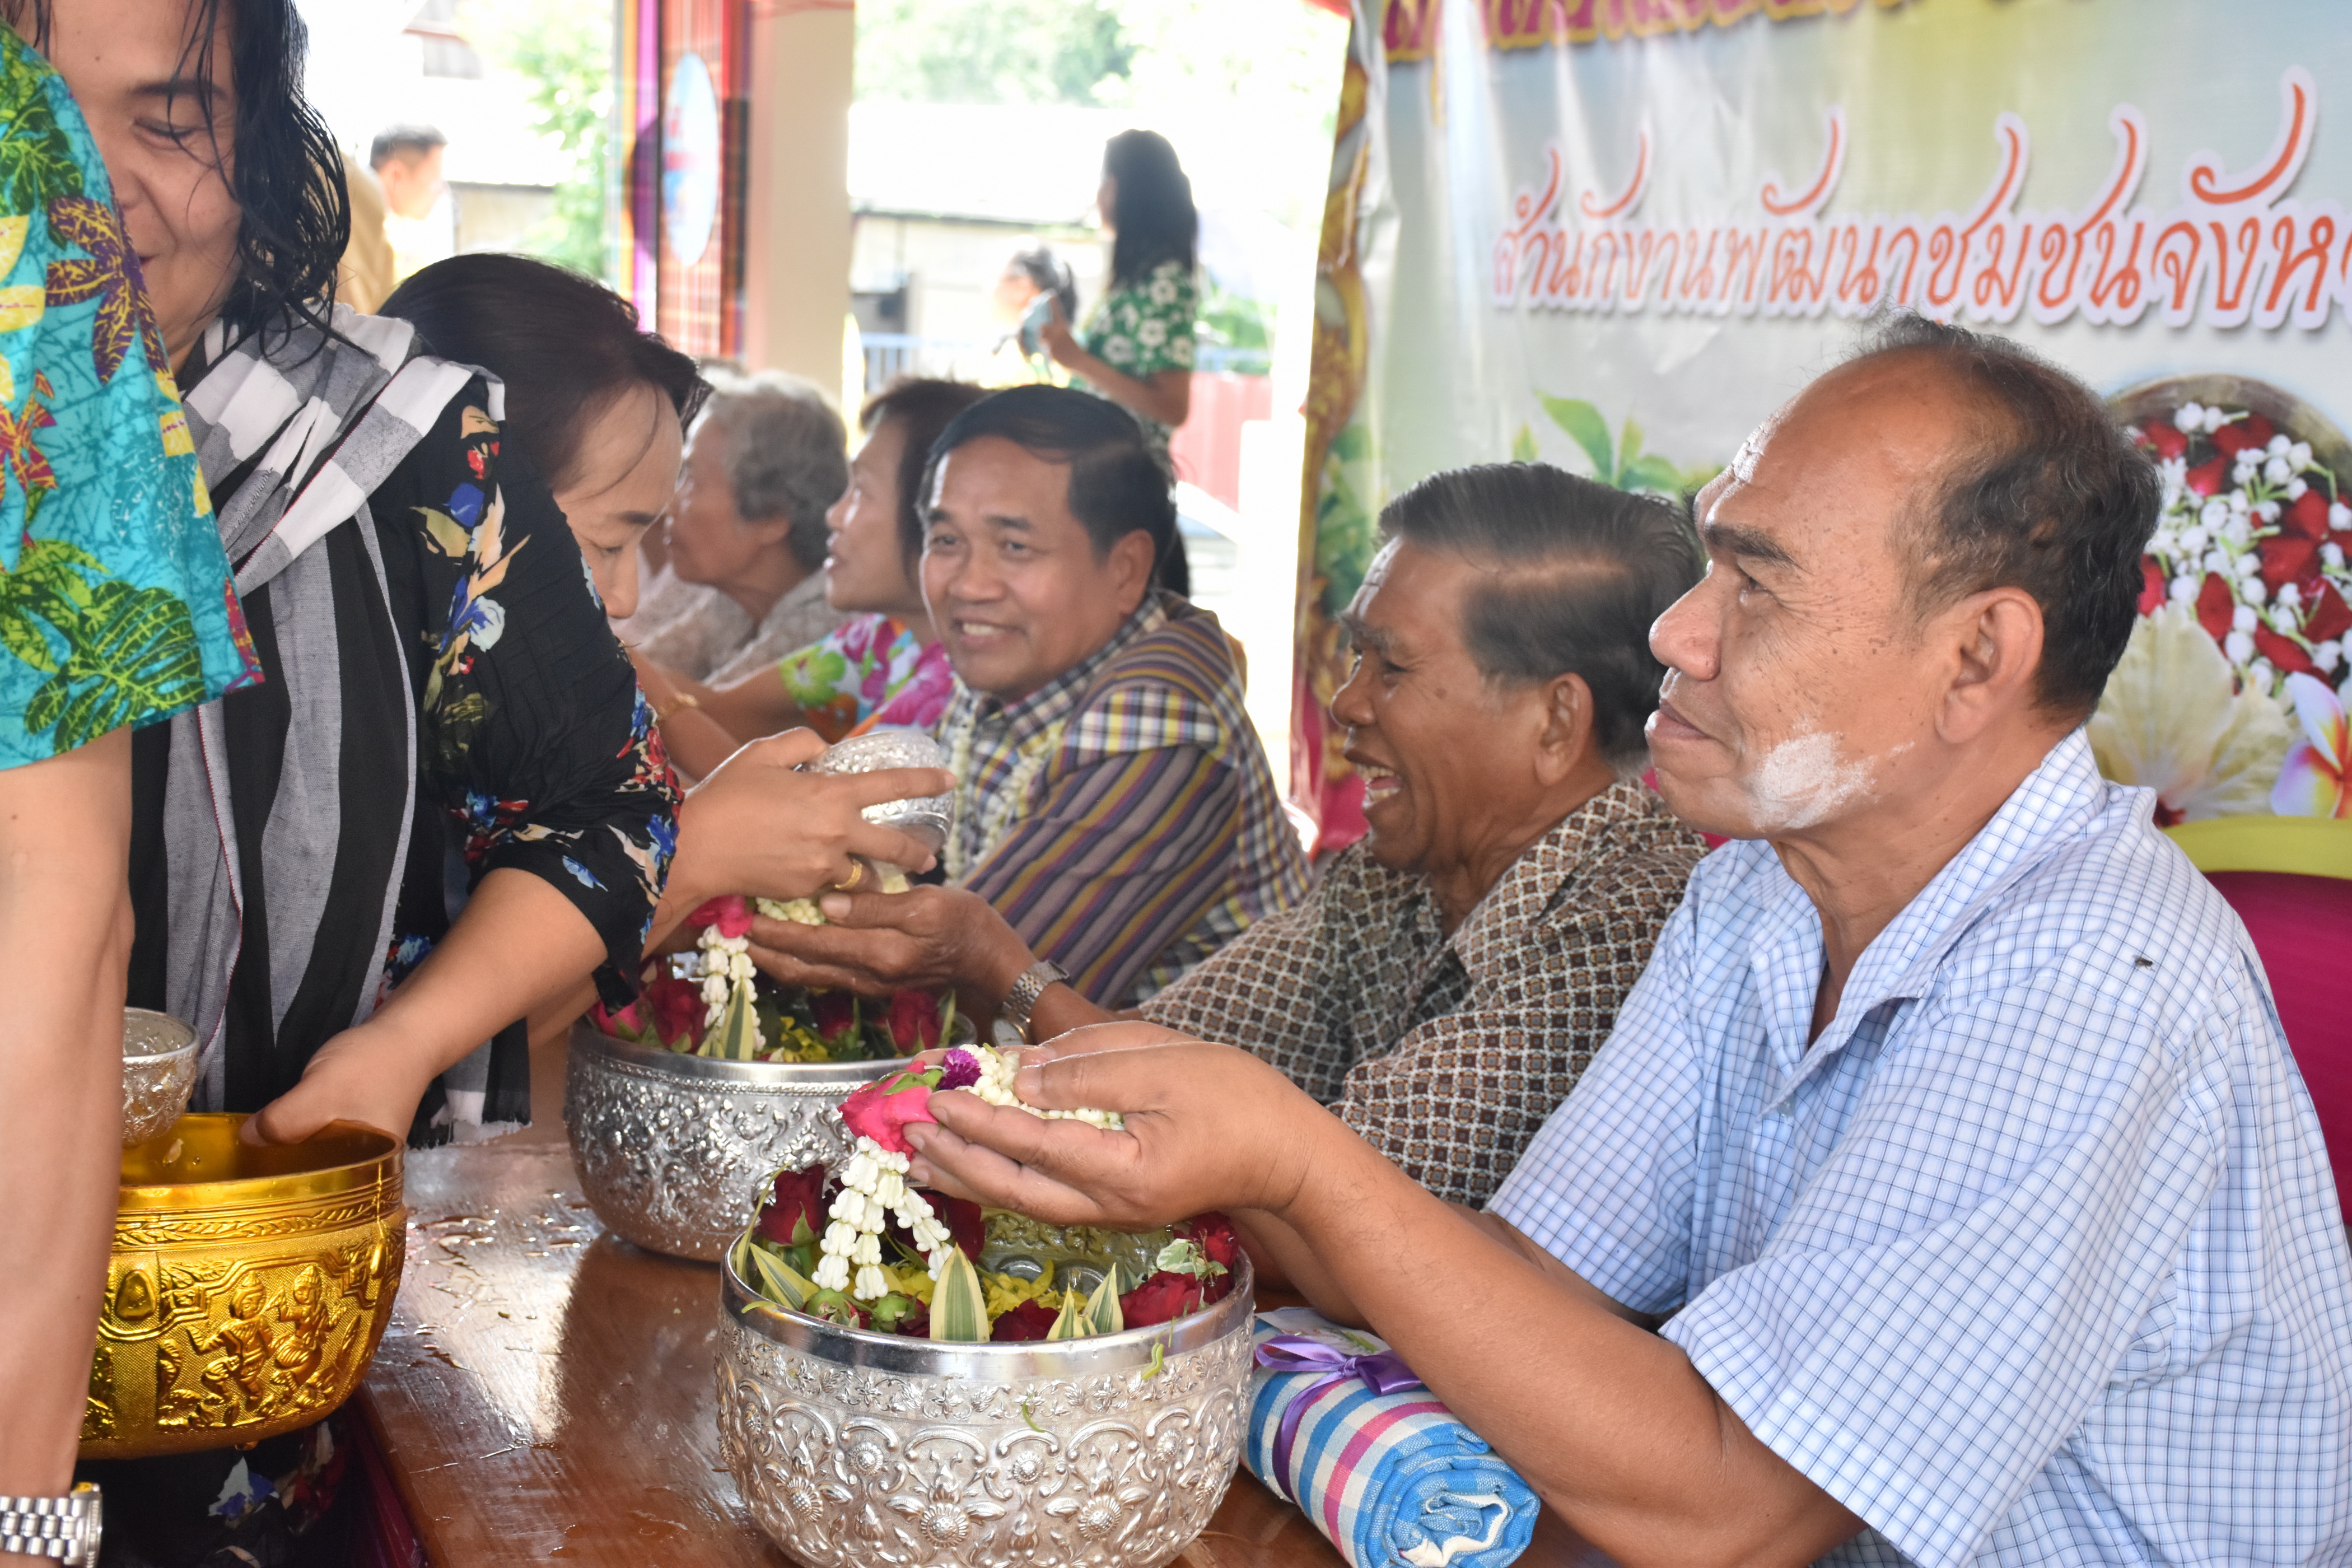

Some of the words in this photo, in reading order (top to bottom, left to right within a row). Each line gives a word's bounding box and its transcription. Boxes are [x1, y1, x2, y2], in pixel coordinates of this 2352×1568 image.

[1492, 81, 2352, 325] สำนักงานพัฒนาชมชนจังห
